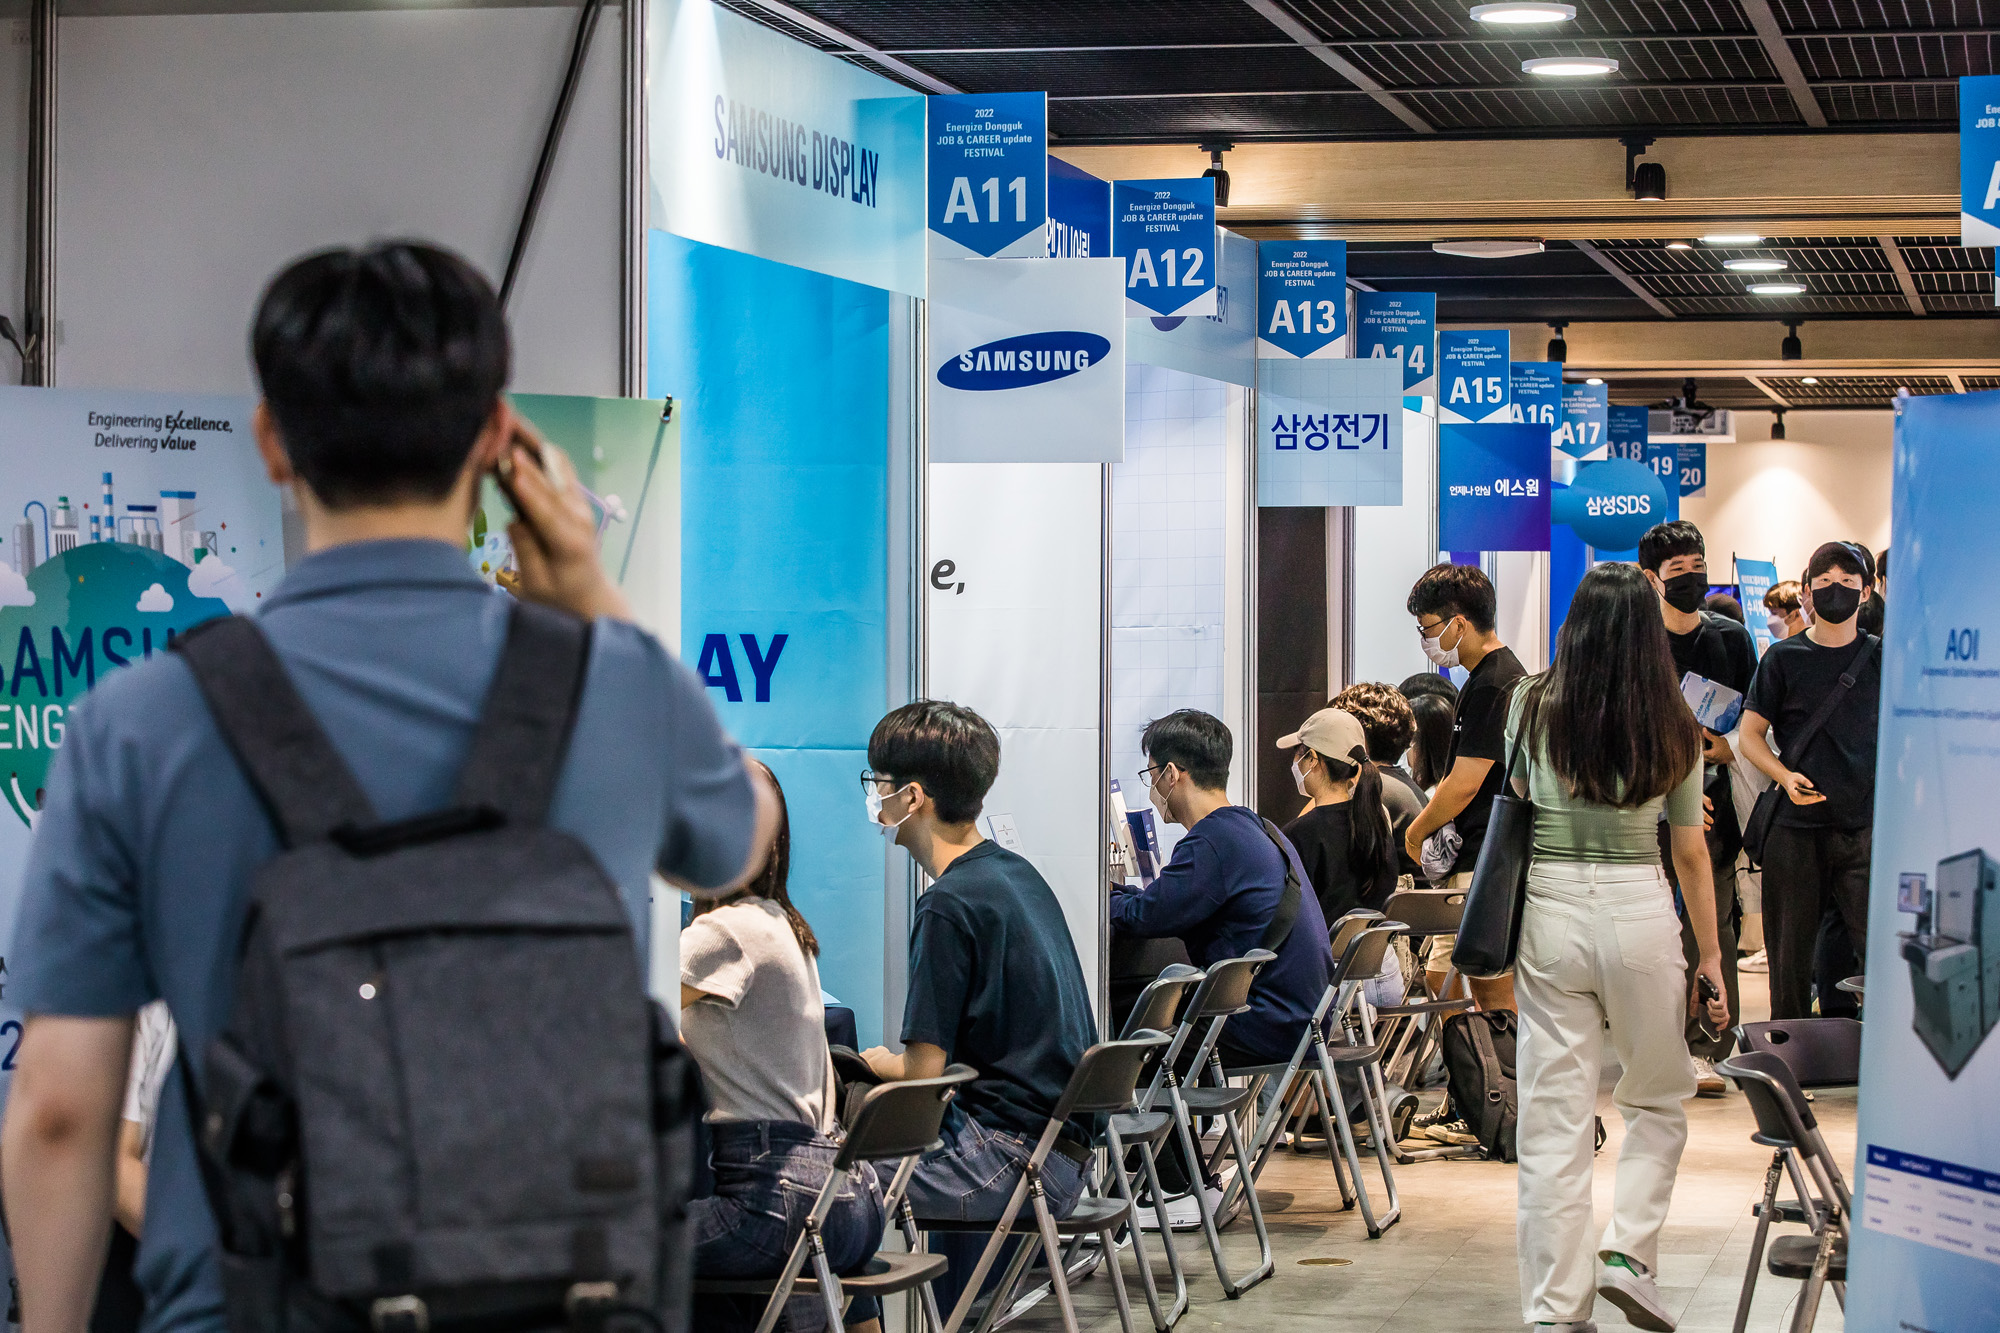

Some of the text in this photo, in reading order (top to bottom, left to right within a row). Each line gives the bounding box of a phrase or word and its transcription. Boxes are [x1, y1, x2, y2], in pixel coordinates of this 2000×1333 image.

[974, 108, 995, 118] 2022
[946, 121, 1023, 133] Energize Dongguk
[1975, 118, 1996, 128] JOB
[937, 134, 1032, 145] JOB & CAREER update
[714, 94, 879, 209] SAMSUNG DISPLAY
[964, 148, 1005, 158] FESTIVAL
[943, 176, 1026, 224] A11
[1154, 191, 1171, 200] 2022
[1129, 202, 1195, 213] Energize Dongguk
[1122, 213, 1204, 222] JOB & CAREER update
[1145, 224, 1180, 233] FESTIVAL
[1127, 248, 1205, 288] A12
[1271, 261, 1329, 269] Energize Dongguk
[1313, 270, 1336, 279] update
[1284, 279, 1315, 287] FESTIVAL
[1268, 299, 1336, 334] A13
[1407, 318, 1427, 326] update
[959, 349, 1090, 372] SAMSUNG
[1449, 376, 1503, 404] A15
[88, 410, 233, 434] Engineering Excellence,
[1510, 403, 1555, 427] A16
[1270, 413, 1389, 452] 삼성전기
[1561, 421, 1601, 445] A17
[94, 432, 158, 453] Delivering
[1607, 440, 1642, 461] A18
[1651, 456, 1673, 476] 19
[1449, 478, 1540, 497] 언제나 안심 에스원
[1585, 494, 1651, 516] 삼성SDS
